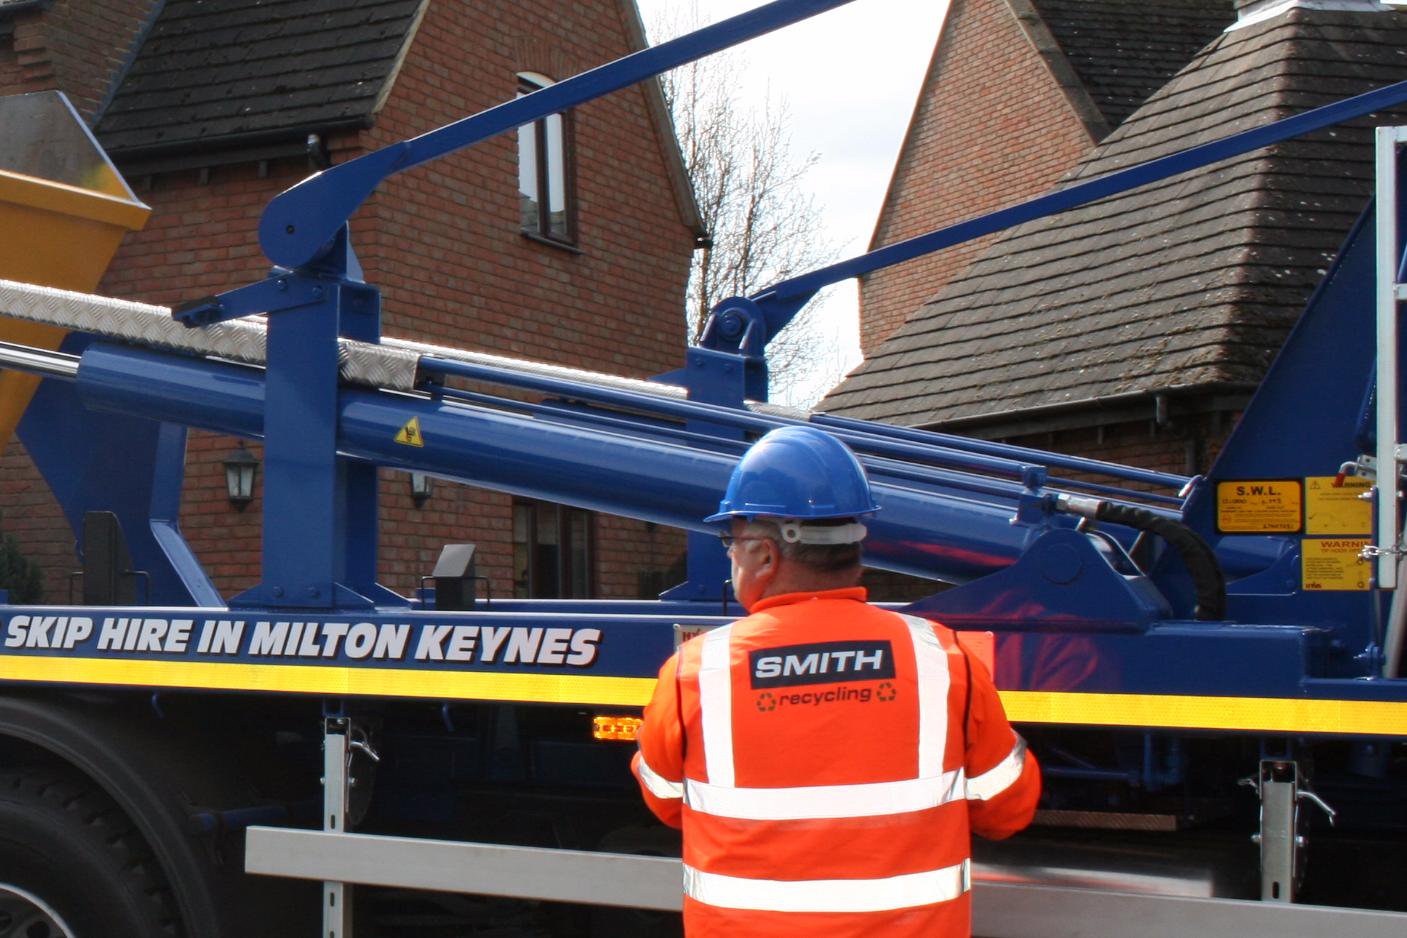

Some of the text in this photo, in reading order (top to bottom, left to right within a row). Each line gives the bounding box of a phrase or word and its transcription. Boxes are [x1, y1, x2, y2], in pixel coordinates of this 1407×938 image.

[1236, 486, 1281, 496] S.W.L.
[5, 616, 93, 649] SKIP
[97, 618, 194, 652] HIRE
[197, 619, 246, 654] IN
[248, 621, 410, 659] MILTON
[414, 625, 601, 666] KEYNES
[755, 650, 883, 678] SMITH
[779, 687, 872, 706] recycling
